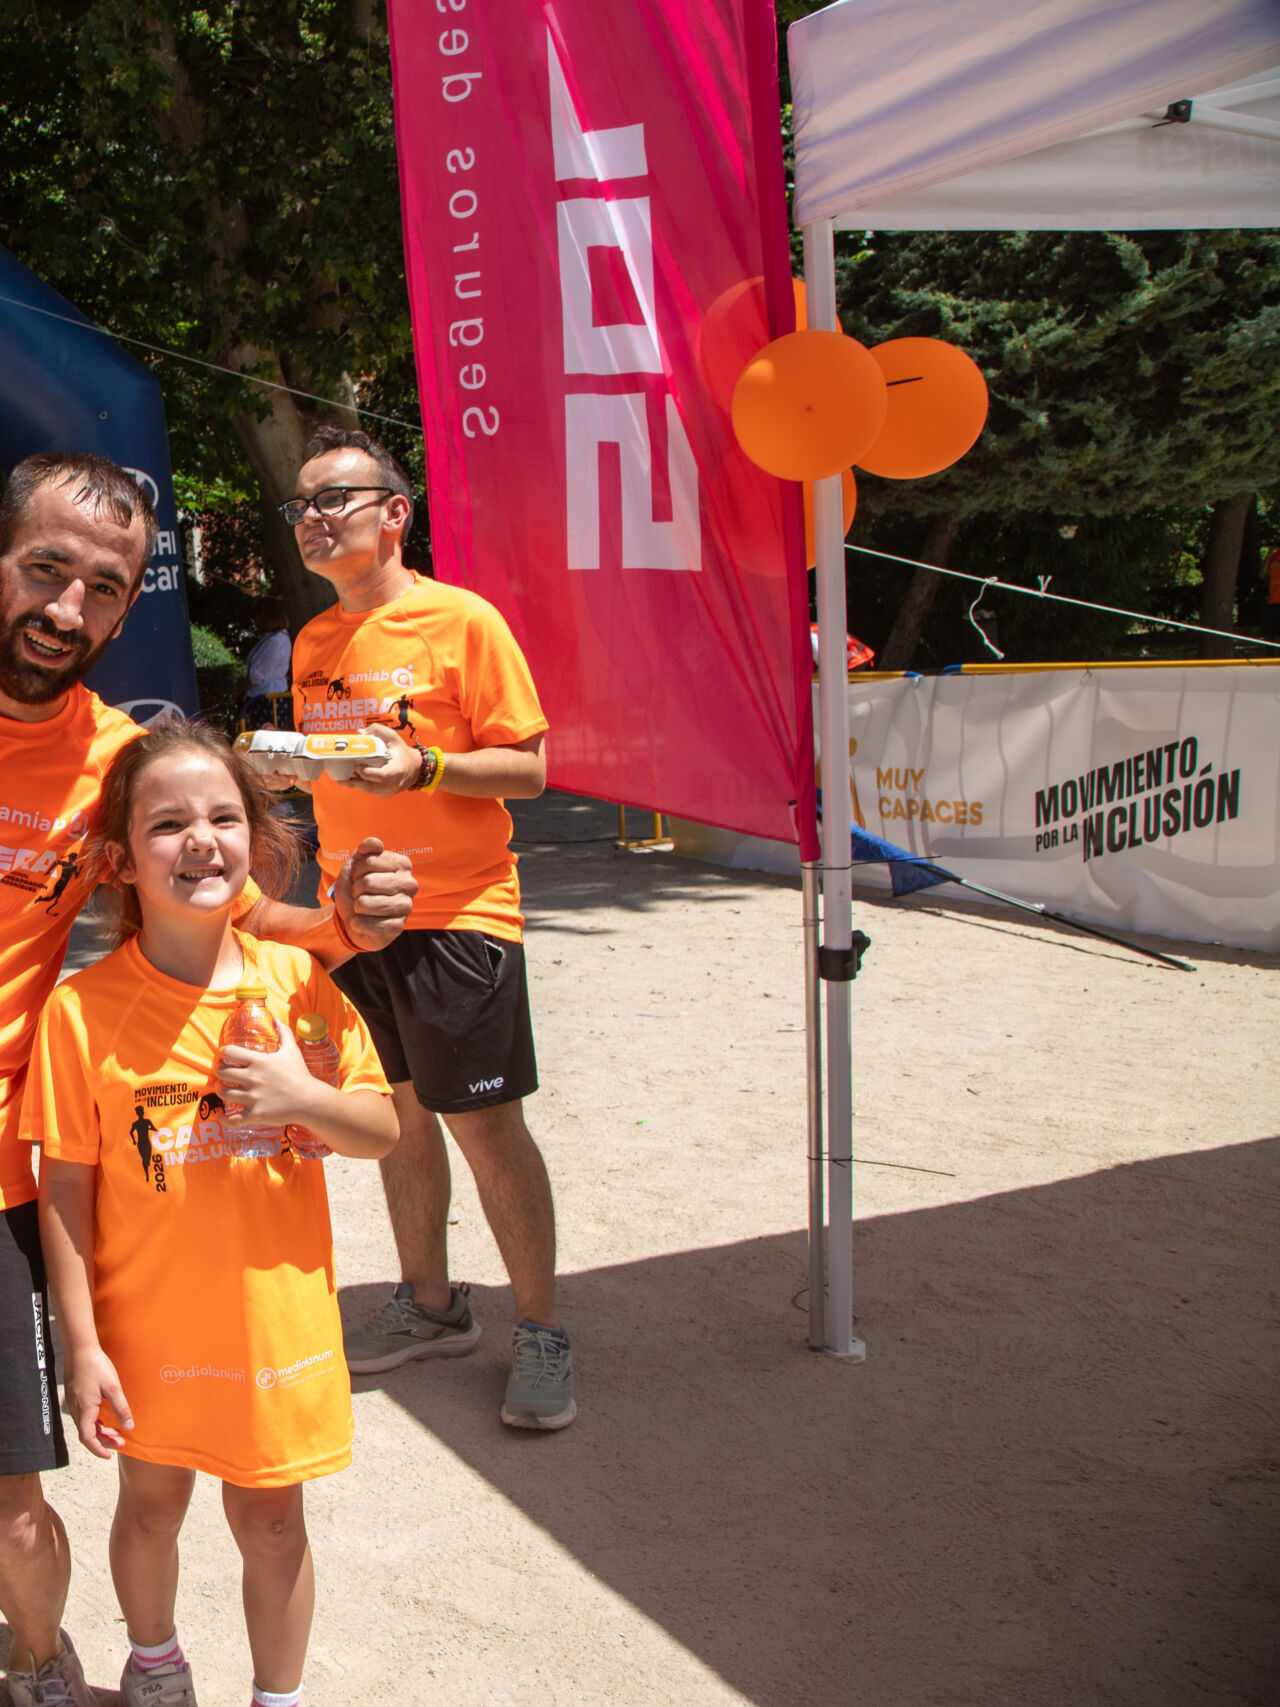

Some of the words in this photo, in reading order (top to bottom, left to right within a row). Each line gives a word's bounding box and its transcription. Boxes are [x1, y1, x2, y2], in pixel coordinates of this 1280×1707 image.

[349, 668, 390, 683] amiab
[302, 697, 397, 720] CARRERA
[303, 718, 365, 732] INCLUSIVA
[876, 767, 925, 792] MUY
[1035, 736, 1198, 829] MOVIMIENTO
[878, 796, 984, 827] CAPACES
[1035, 829, 1060, 853] POR
[1063, 823, 1079, 844] LA
[1082, 761, 1241, 863] INCLUSIÓN
[134, 1083, 187, 1098] MOVIMIENTO
[468, 1077, 504, 1094] vive
[146, 1090, 198, 1107] INCLUSIÓN
[152, 1153, 167, 1192] 2026
[35, 1299, 44, 1347] JACK
[40, 1369, 51, 1435] JONES
[162, 1363, 246, 1383] mediolanum
[278, 1350, 333, 1378] mediolanum
[141, 1683, 163, 1697] FILA
